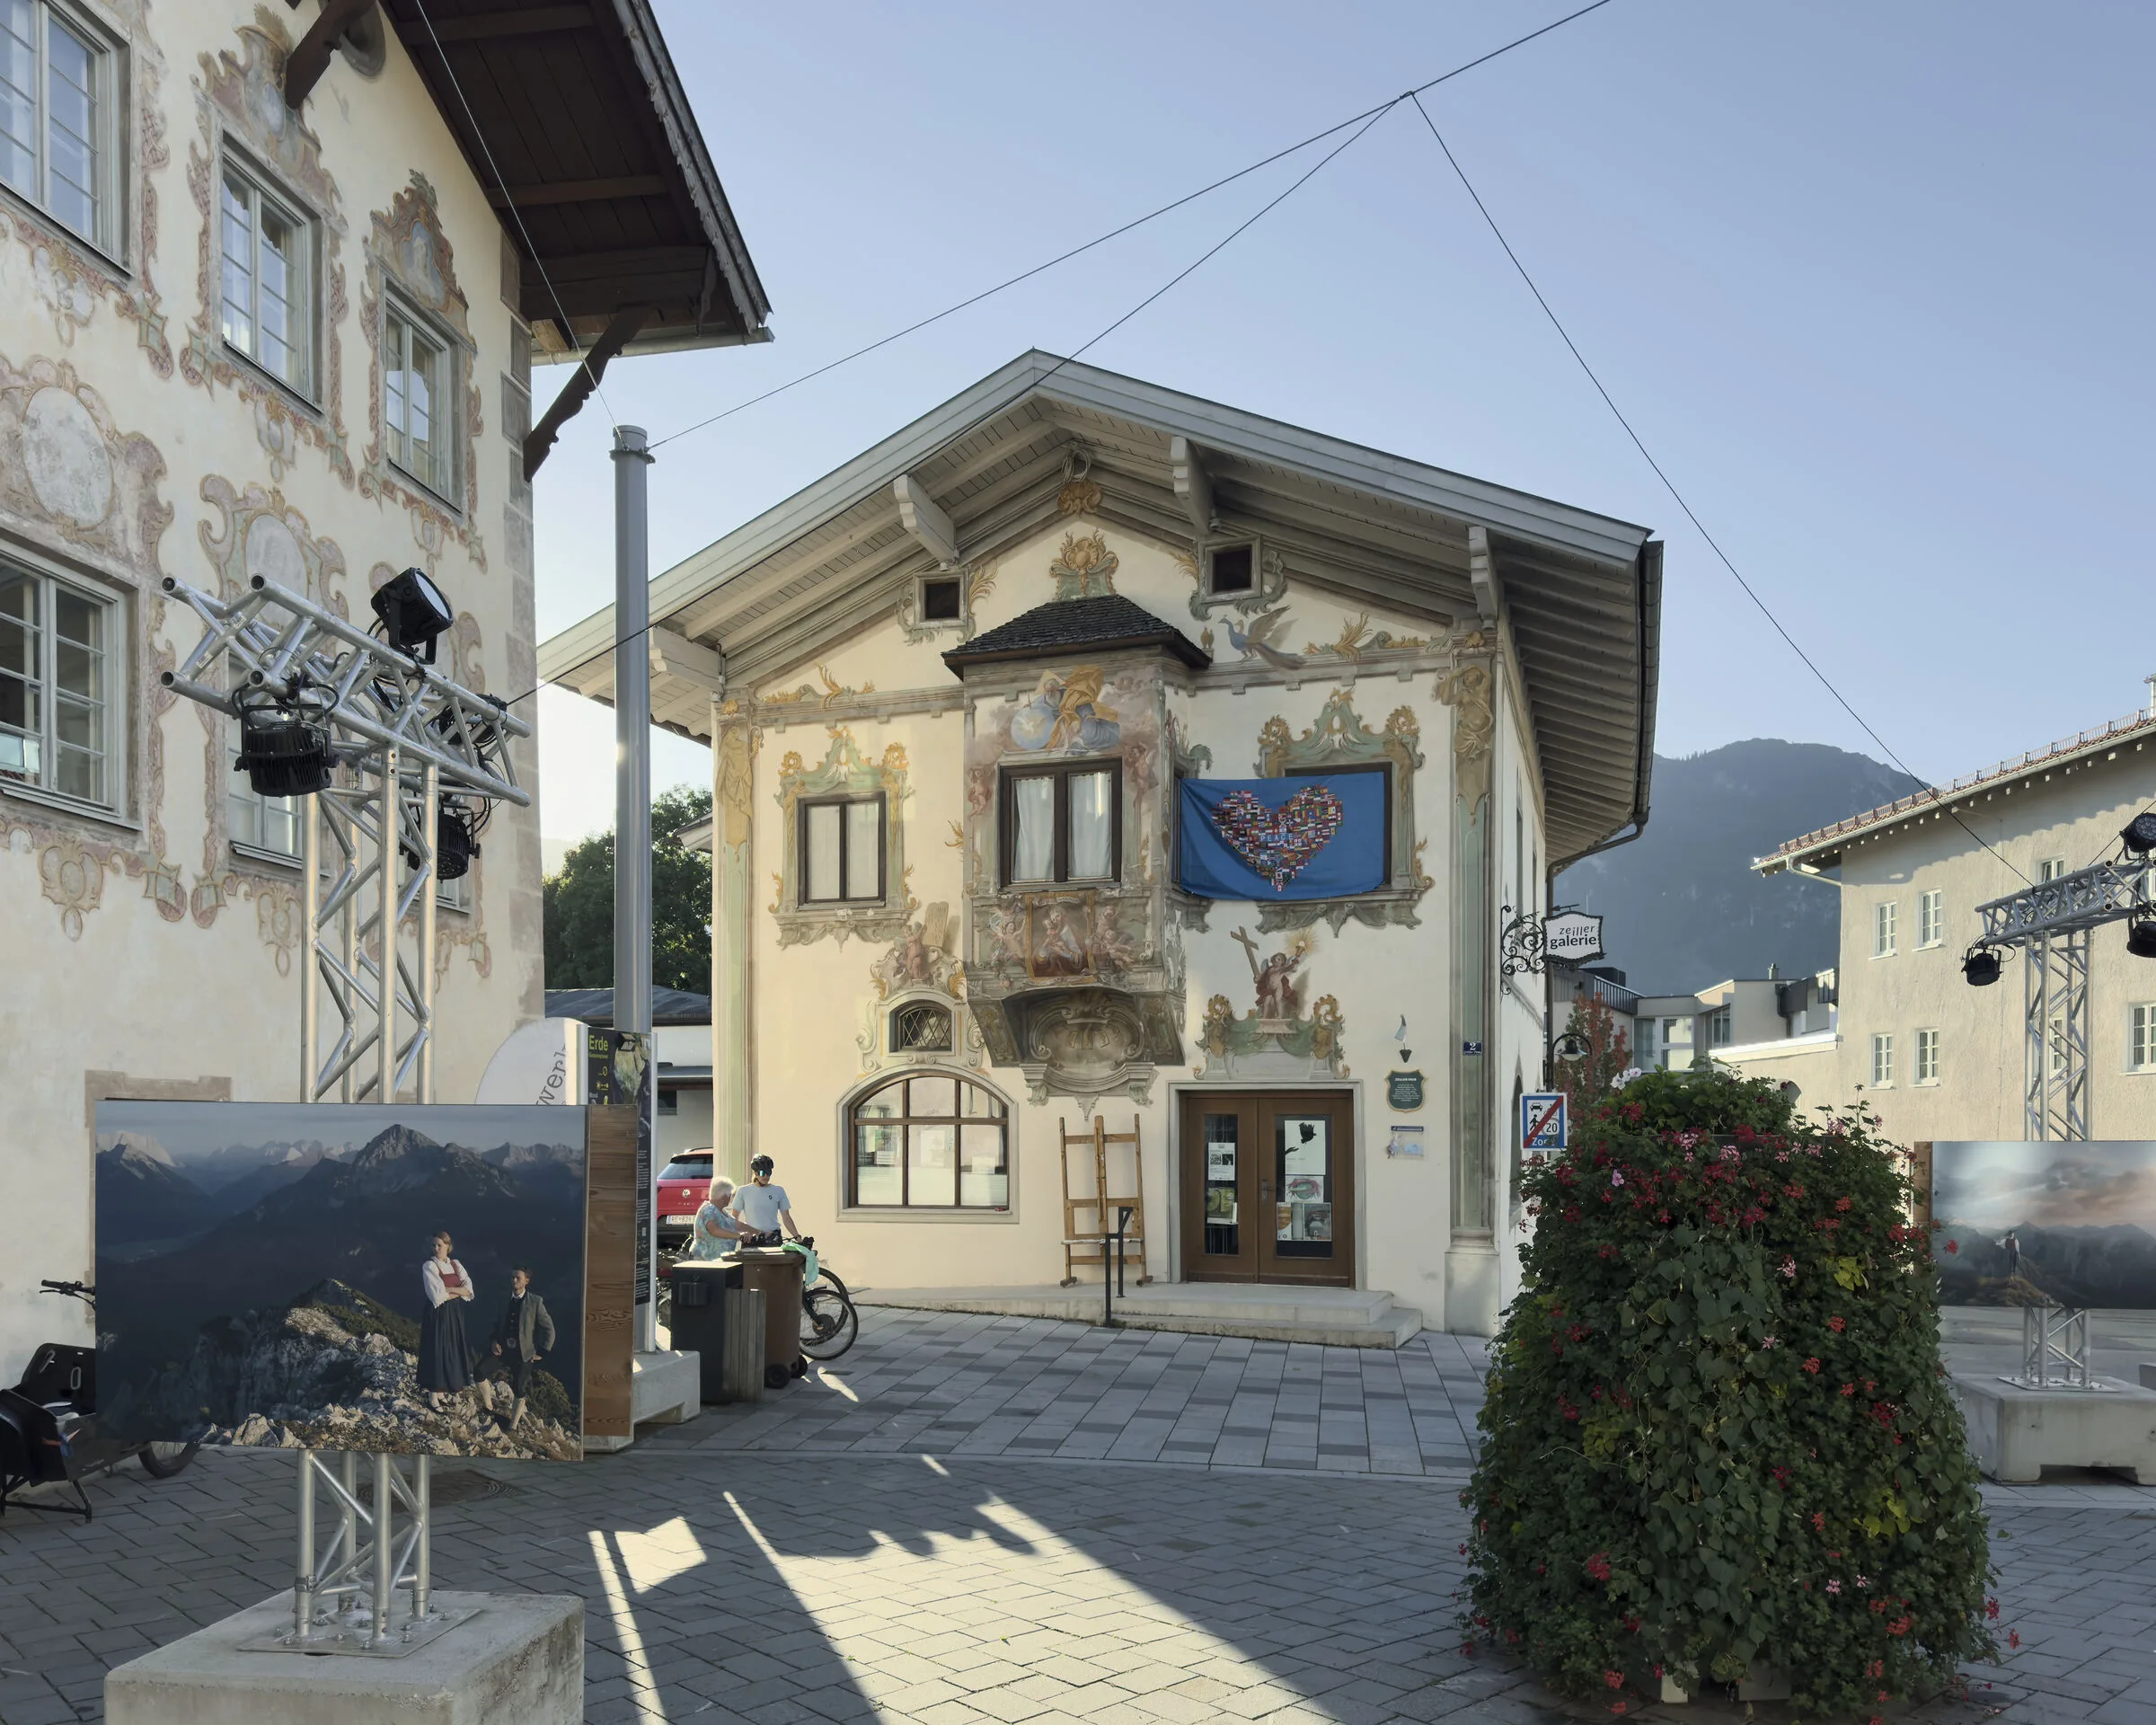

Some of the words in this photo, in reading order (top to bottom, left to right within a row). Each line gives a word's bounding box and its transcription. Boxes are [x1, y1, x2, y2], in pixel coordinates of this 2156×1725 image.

[1259, 833, 1294, 842] PEACE
[1560, 925, 1595, 935] zeiller
[1550, 934, 1596, 950] galerie
[588, 1035, 608, 1051] Erde
[1469, 1042, 1476, 1050] 2
[1546, 1123, 1558, 1133] 20
